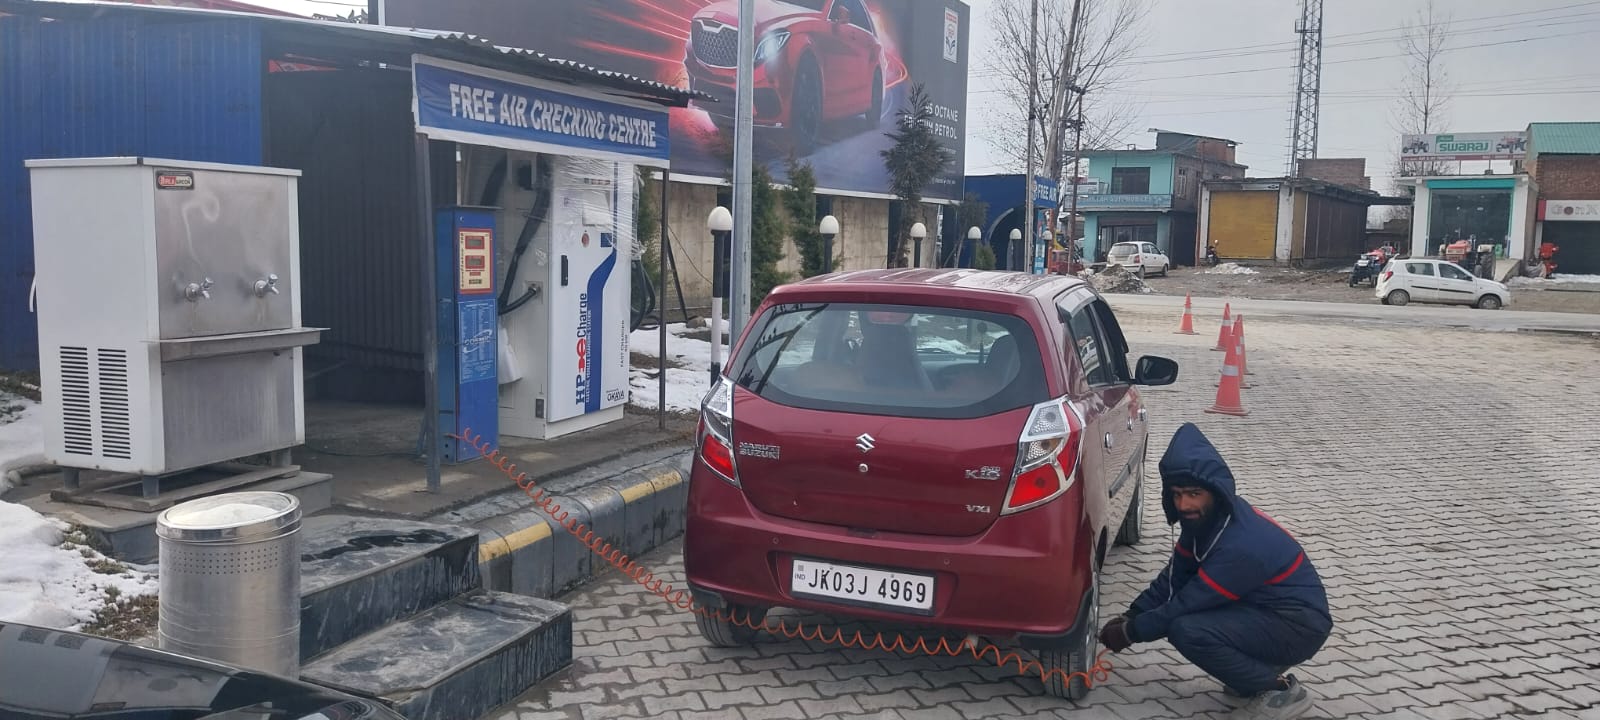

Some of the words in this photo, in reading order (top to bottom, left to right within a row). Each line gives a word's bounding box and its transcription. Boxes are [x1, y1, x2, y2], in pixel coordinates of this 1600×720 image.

[449, 83, 496, 122] FREE
[500, 93, 528, 128] AIR
[530, 99, 605, 140] CHECKING
[608, 114, 657, 148] CENTRE
[934, 105, 959, 122] OCTANE
[934, 123, 958, 140] PETROL
[1037, 184, 1049, 200] FREE
[575, 374, 586, 405] HP
[607, 390, 625, 402] OKAYA
[739, 442, 780, 452] MARUTI
[739, 449, 780, 460] SUZUKI
[794, 573, 806, 581] IND
[808, 568, 868, 595] JK03J
[878, 578, 926, 603] 4969
